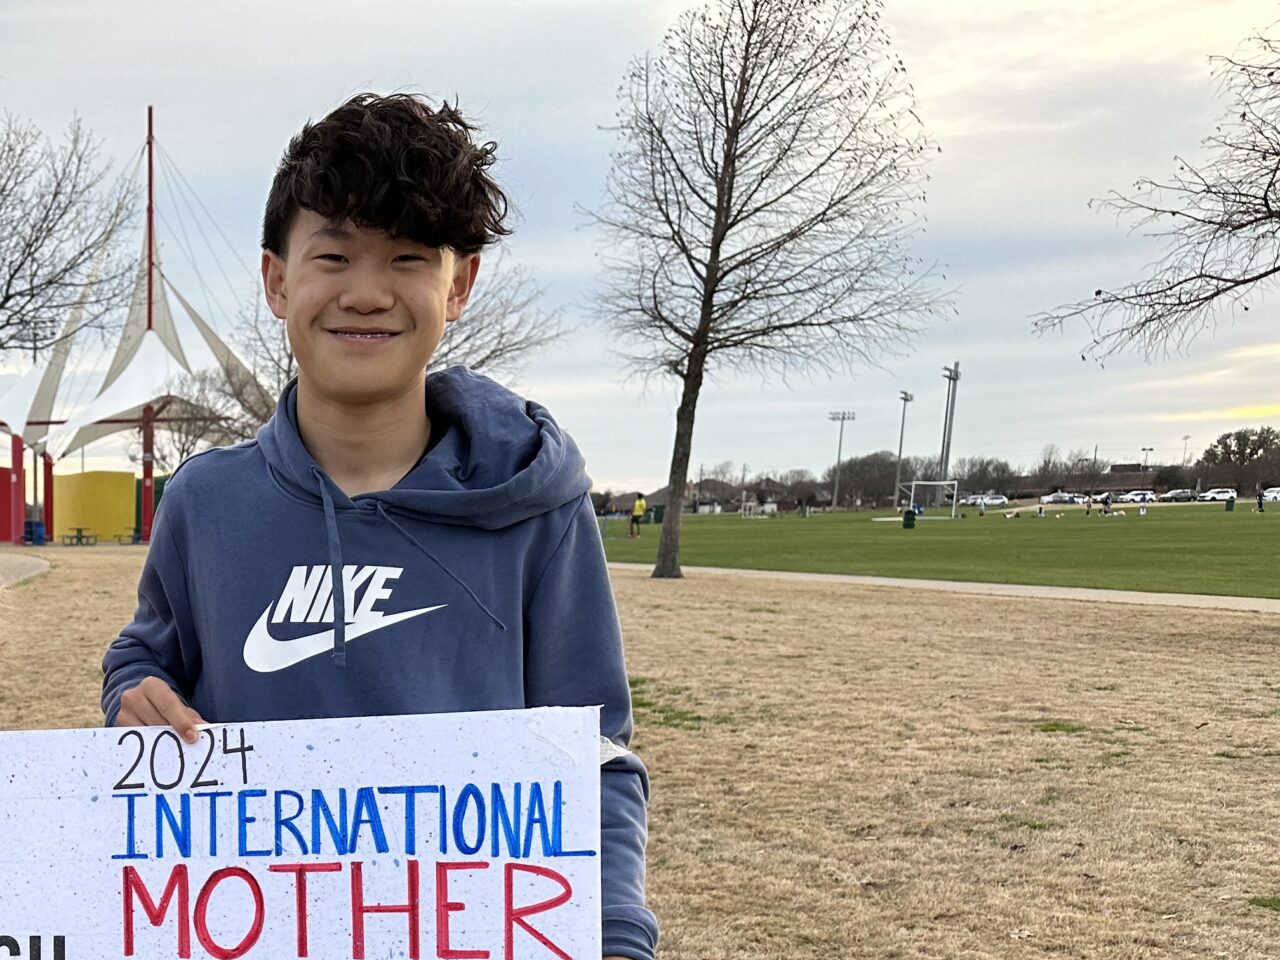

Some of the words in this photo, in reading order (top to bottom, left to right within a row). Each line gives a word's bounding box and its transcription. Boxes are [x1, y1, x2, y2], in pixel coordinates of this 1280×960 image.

[271, 564, 404, 623] NIKE
[112, 728, 254, 791] 2024
[111, 780, 596, 860] INTERNATIONAL
